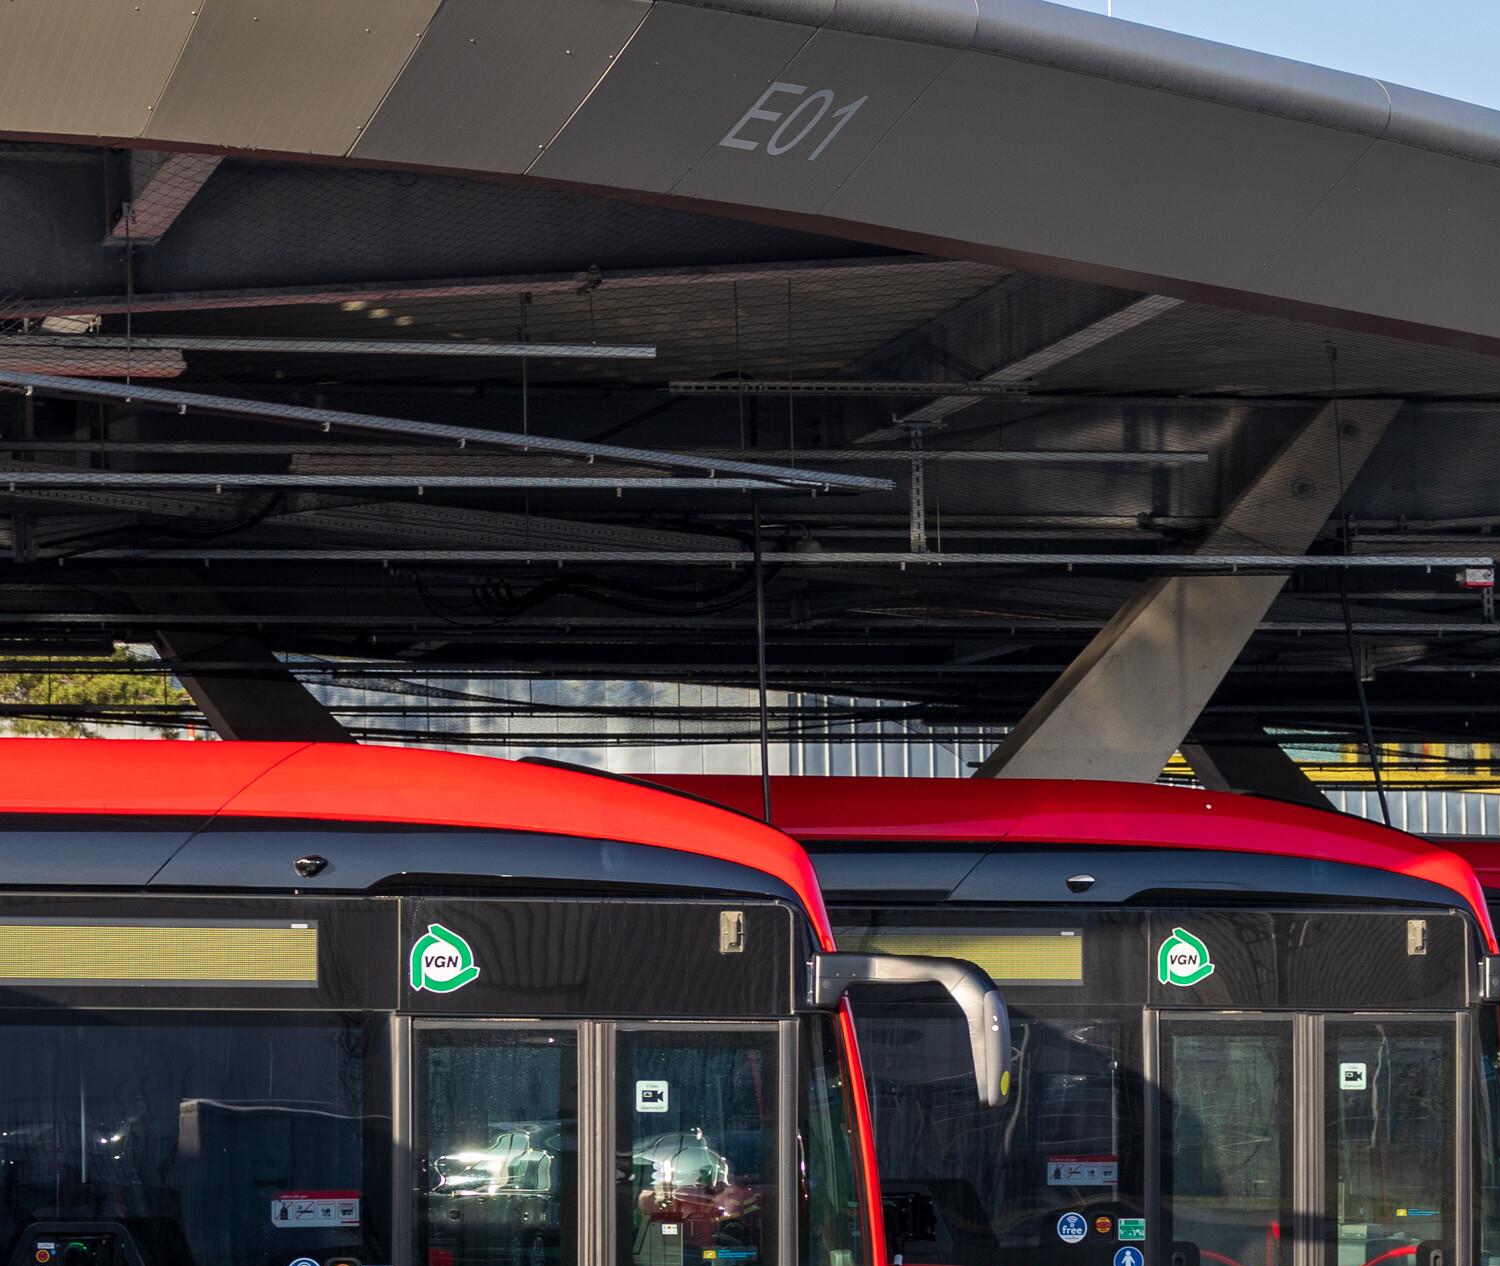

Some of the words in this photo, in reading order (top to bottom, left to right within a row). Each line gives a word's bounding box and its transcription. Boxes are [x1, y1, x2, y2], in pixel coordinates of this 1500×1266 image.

[719, 81, 869, 161] E01
[424, 955, 459, 969] VGN
[1169, 954, 1198, 965] VGN
[1062, 1225, 1083, 1235] free
